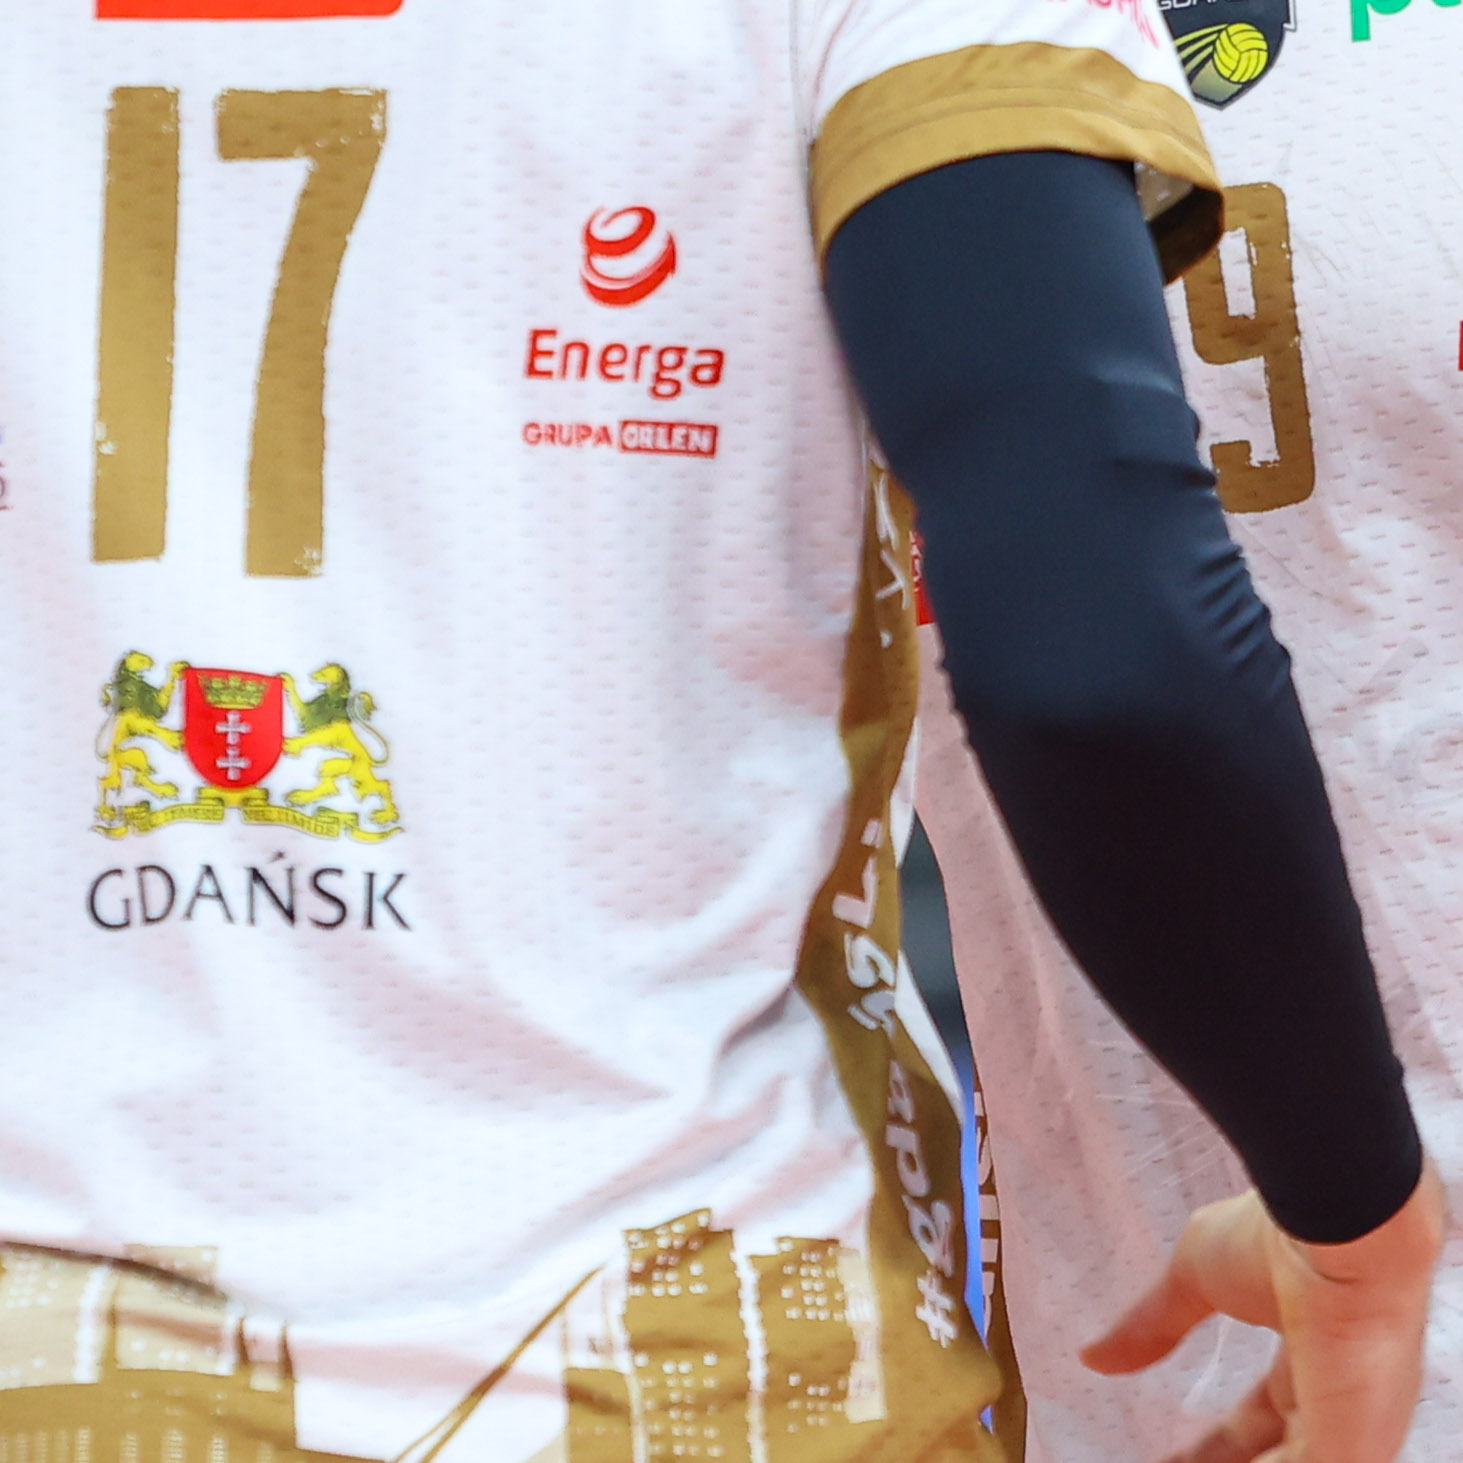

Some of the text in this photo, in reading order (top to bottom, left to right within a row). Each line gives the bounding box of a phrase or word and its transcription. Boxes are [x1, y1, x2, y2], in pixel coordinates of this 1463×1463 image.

[90, 85, 389, 580] 17
[524, 328, 726, 401] Energa
[523, 421, 714, 454] GRUPA ORLEN
[88, 849, 412, 932] GDAŃSK
